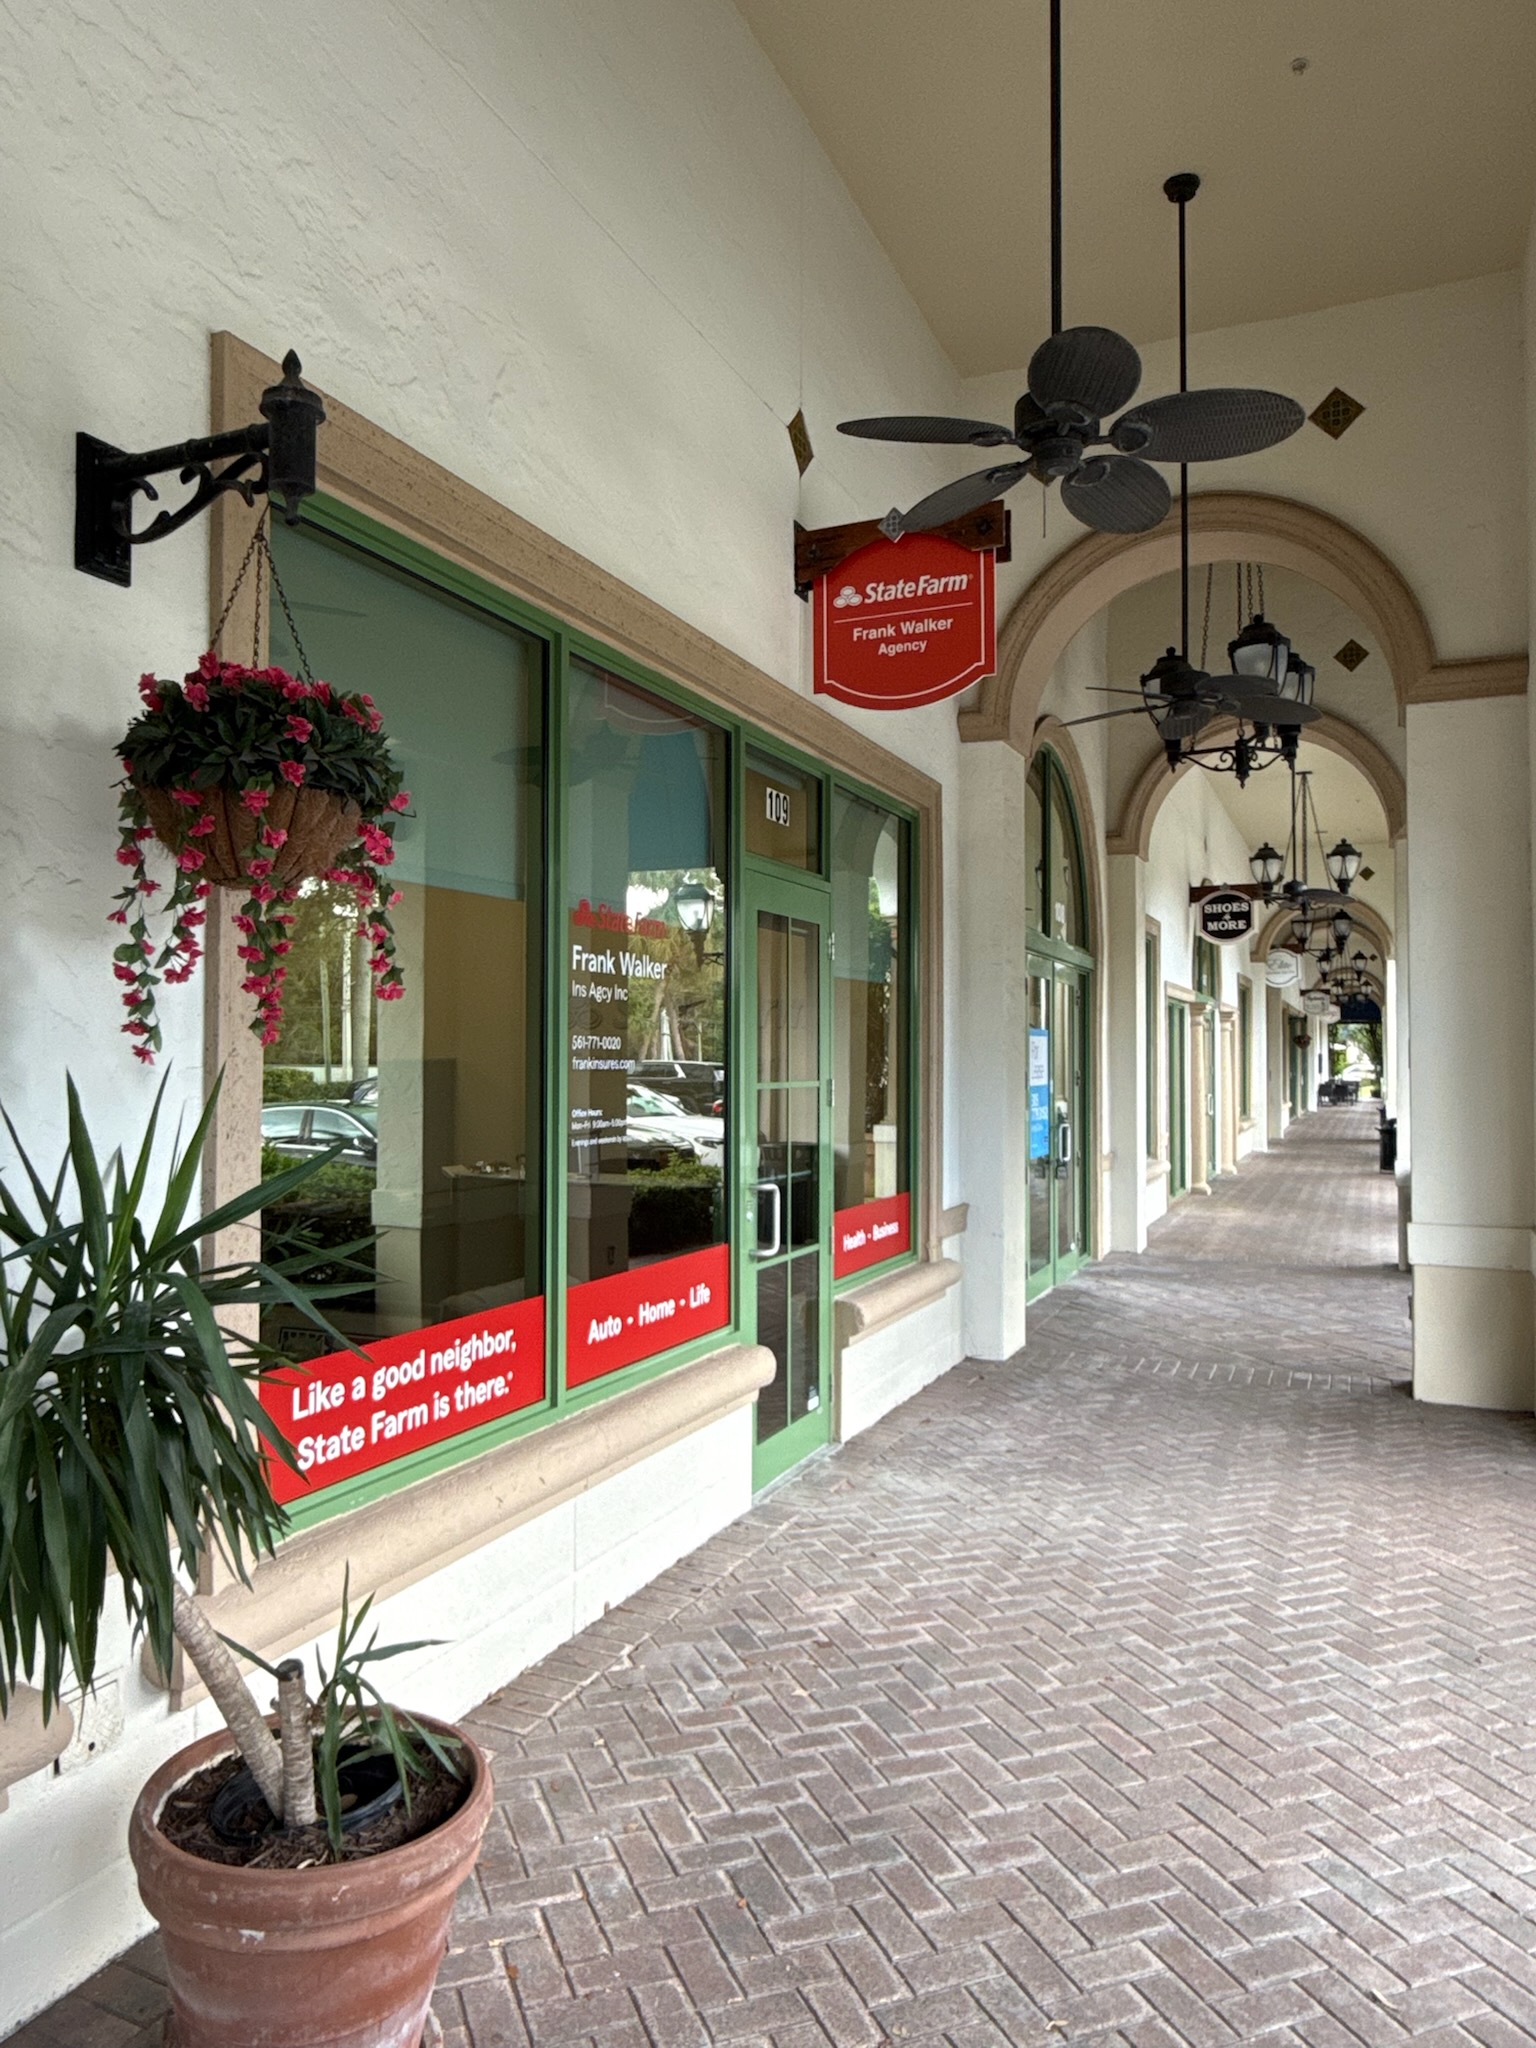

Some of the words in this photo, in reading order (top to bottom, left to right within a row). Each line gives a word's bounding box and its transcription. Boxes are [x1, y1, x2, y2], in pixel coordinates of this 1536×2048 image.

[853, 624, 896, 641] Frank
[900, 618, 954, 635] Walker
[878, 640, 928, 657] Agency
[768, 790, 789, 825] 109
[1204, 902, 1249, 913] SHOES
[1207, 920, 1247, 930] MORE
[572, 944, 616, 975] Frank
[619, 951, 667, 980] Walker
[572, 980, 587, 998] Ins
[589, 981, 613, 1003] Agcy
[614, 983, 629, 1001] Inc
[572, 1035, 621, 1050] 561-771-0020
[572, 1056, 636, 1071] frankinsures.com
[587, 1315, 622, 1345] Auto
[638, 1299, 676, 1327] Home
[689, 1283, 711, 1309] Life
[292, 1380, 345, 1421] Like
[351, 1375, 366, 1400] a
[371, 1349, 426, 1401] good
[430, 1329, 517, 1375] neighbor,
[297, 1425, 366, 1471] State
[371, 1403, 429, 1445] Farm
[433, 1391, 450, 1419] is
